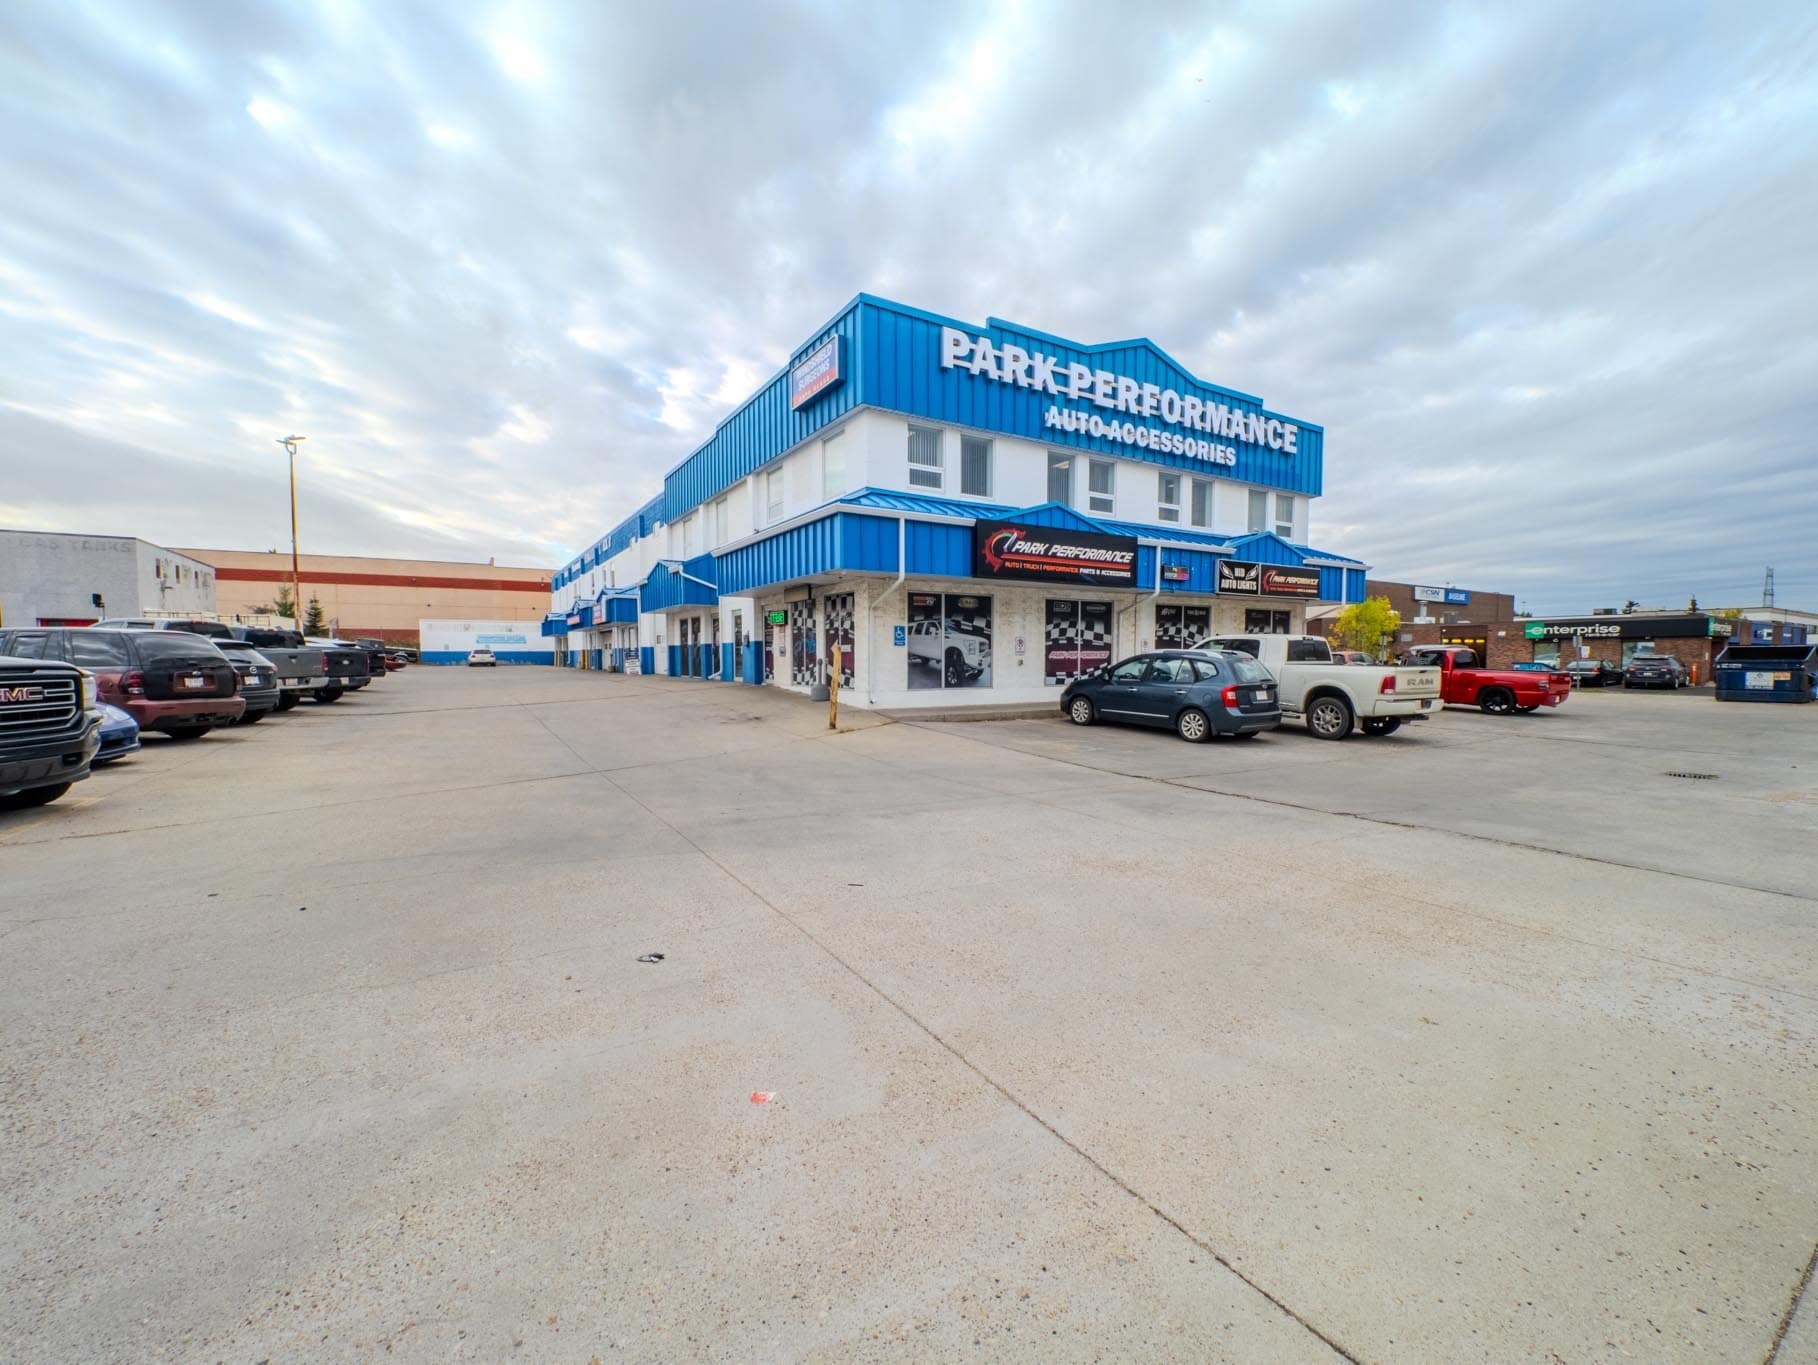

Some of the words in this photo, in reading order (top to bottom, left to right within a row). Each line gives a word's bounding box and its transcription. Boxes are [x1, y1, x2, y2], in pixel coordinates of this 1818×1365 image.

[941, 327, 1059, 396] PARK
[1068, 361, 1298, 454] PERFORMANCE
[1045, 405, 1104, 438] AUTO
[1107, 422, 1237, 467] ACCESSORIES
[1014, 541, 1049, 554] PARK
[1049, 545, 1134, 563] PERFORMANCE
[1221, 578, 1237, 589] AUTO
[1237, 580, 1257, 591] LIGHTS
[1528, 622, 1622, 637] enterprise
[1407, 678, 1434, 686] RAM
[0, 686, 43, 702] MC
